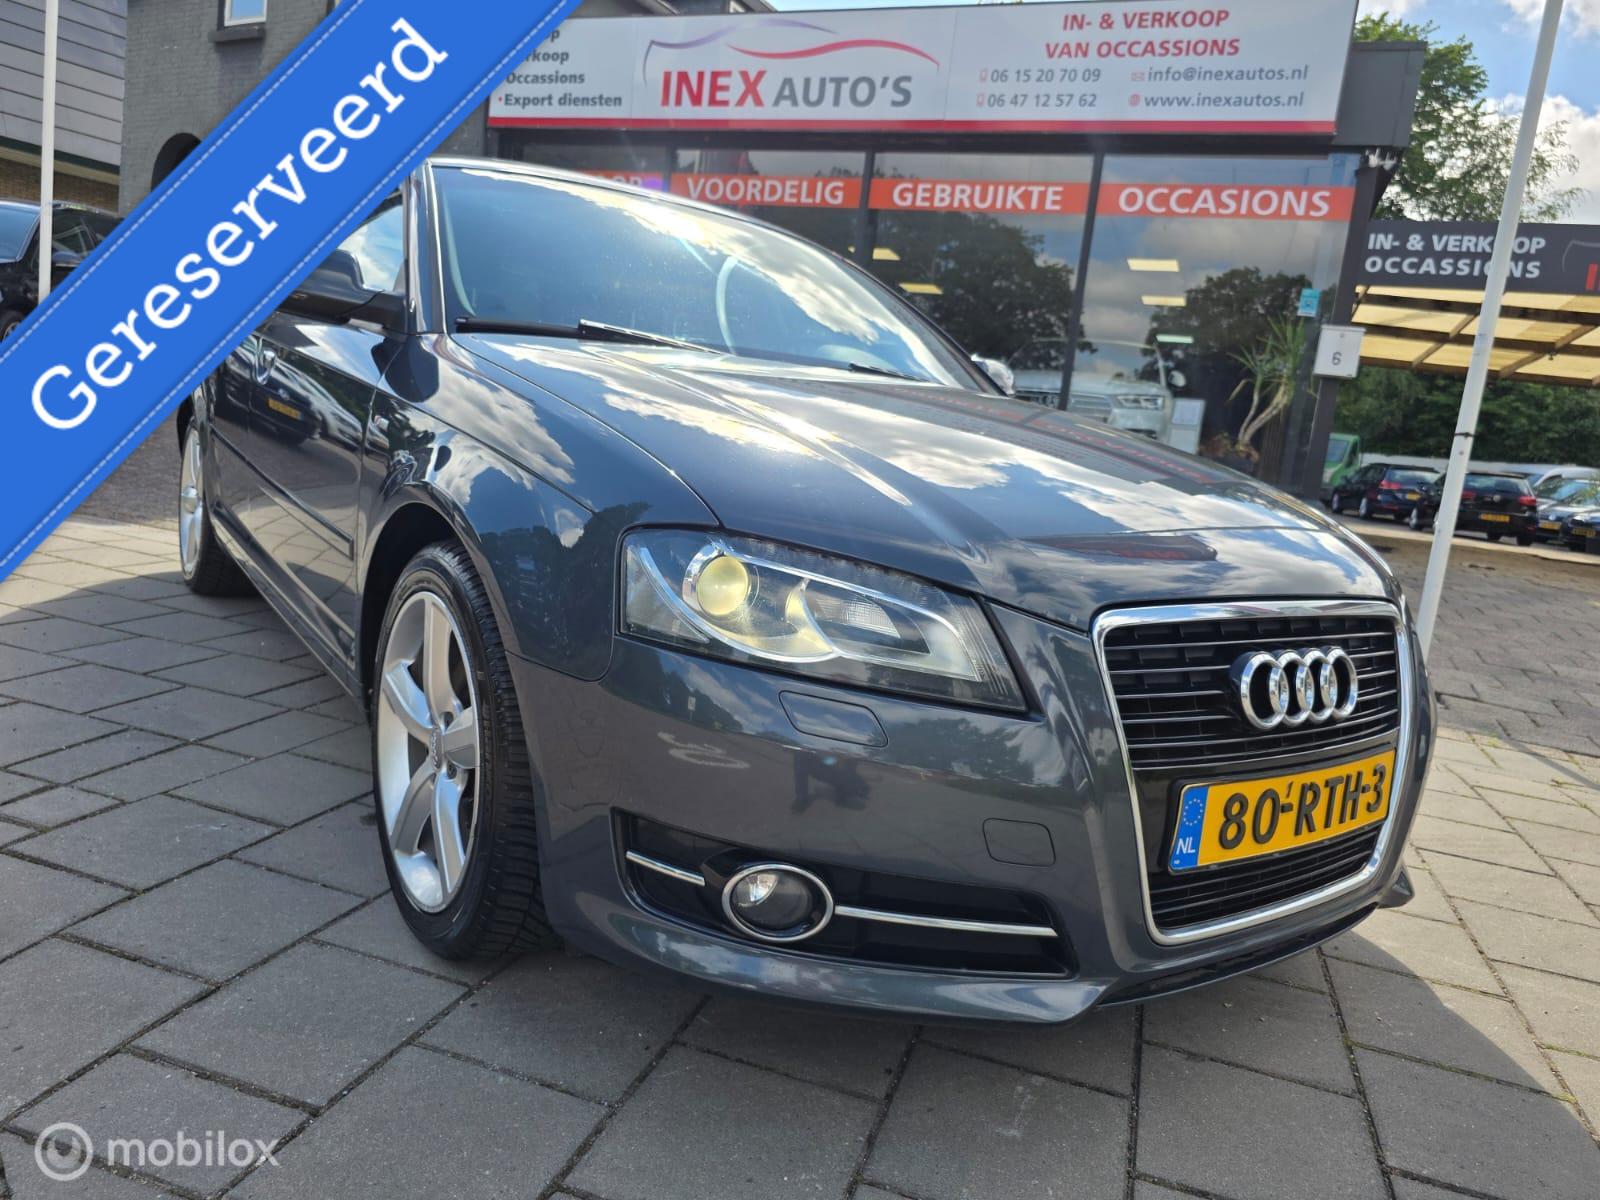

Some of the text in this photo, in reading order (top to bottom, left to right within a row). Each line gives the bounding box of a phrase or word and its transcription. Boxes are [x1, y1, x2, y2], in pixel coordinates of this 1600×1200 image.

[1062, 10, 1229, 31] IN- & VERKOOP
[1045, 39, 1240, 59] VAN OCCASSIONS
[506, 70, 585, 85] Occassions
[990, 68, 1101, 83] 06 15 20 70 09
[1148, 64, 1309, 81] info@inexautos.nl
[660, 70, 912, 108] INEX AUTO'S
[558, 92, 622, 107] diensten
[987, 93, 1097, 108] 06 47 12 57 62
[1144, 92, 1304, 107] www.inexautos.nl
[687, 177, 844, 205] VOORDELIG
[892, 182, 1064, 211] GEBRUIKTE
[1118, 187, 1330, 217] OCCASIONS
[1367, 233, 1546, 254] IN- & VERKOP
[1331, 351, 1343, 366] 6
[1176, 837, 1196, 855] NL
